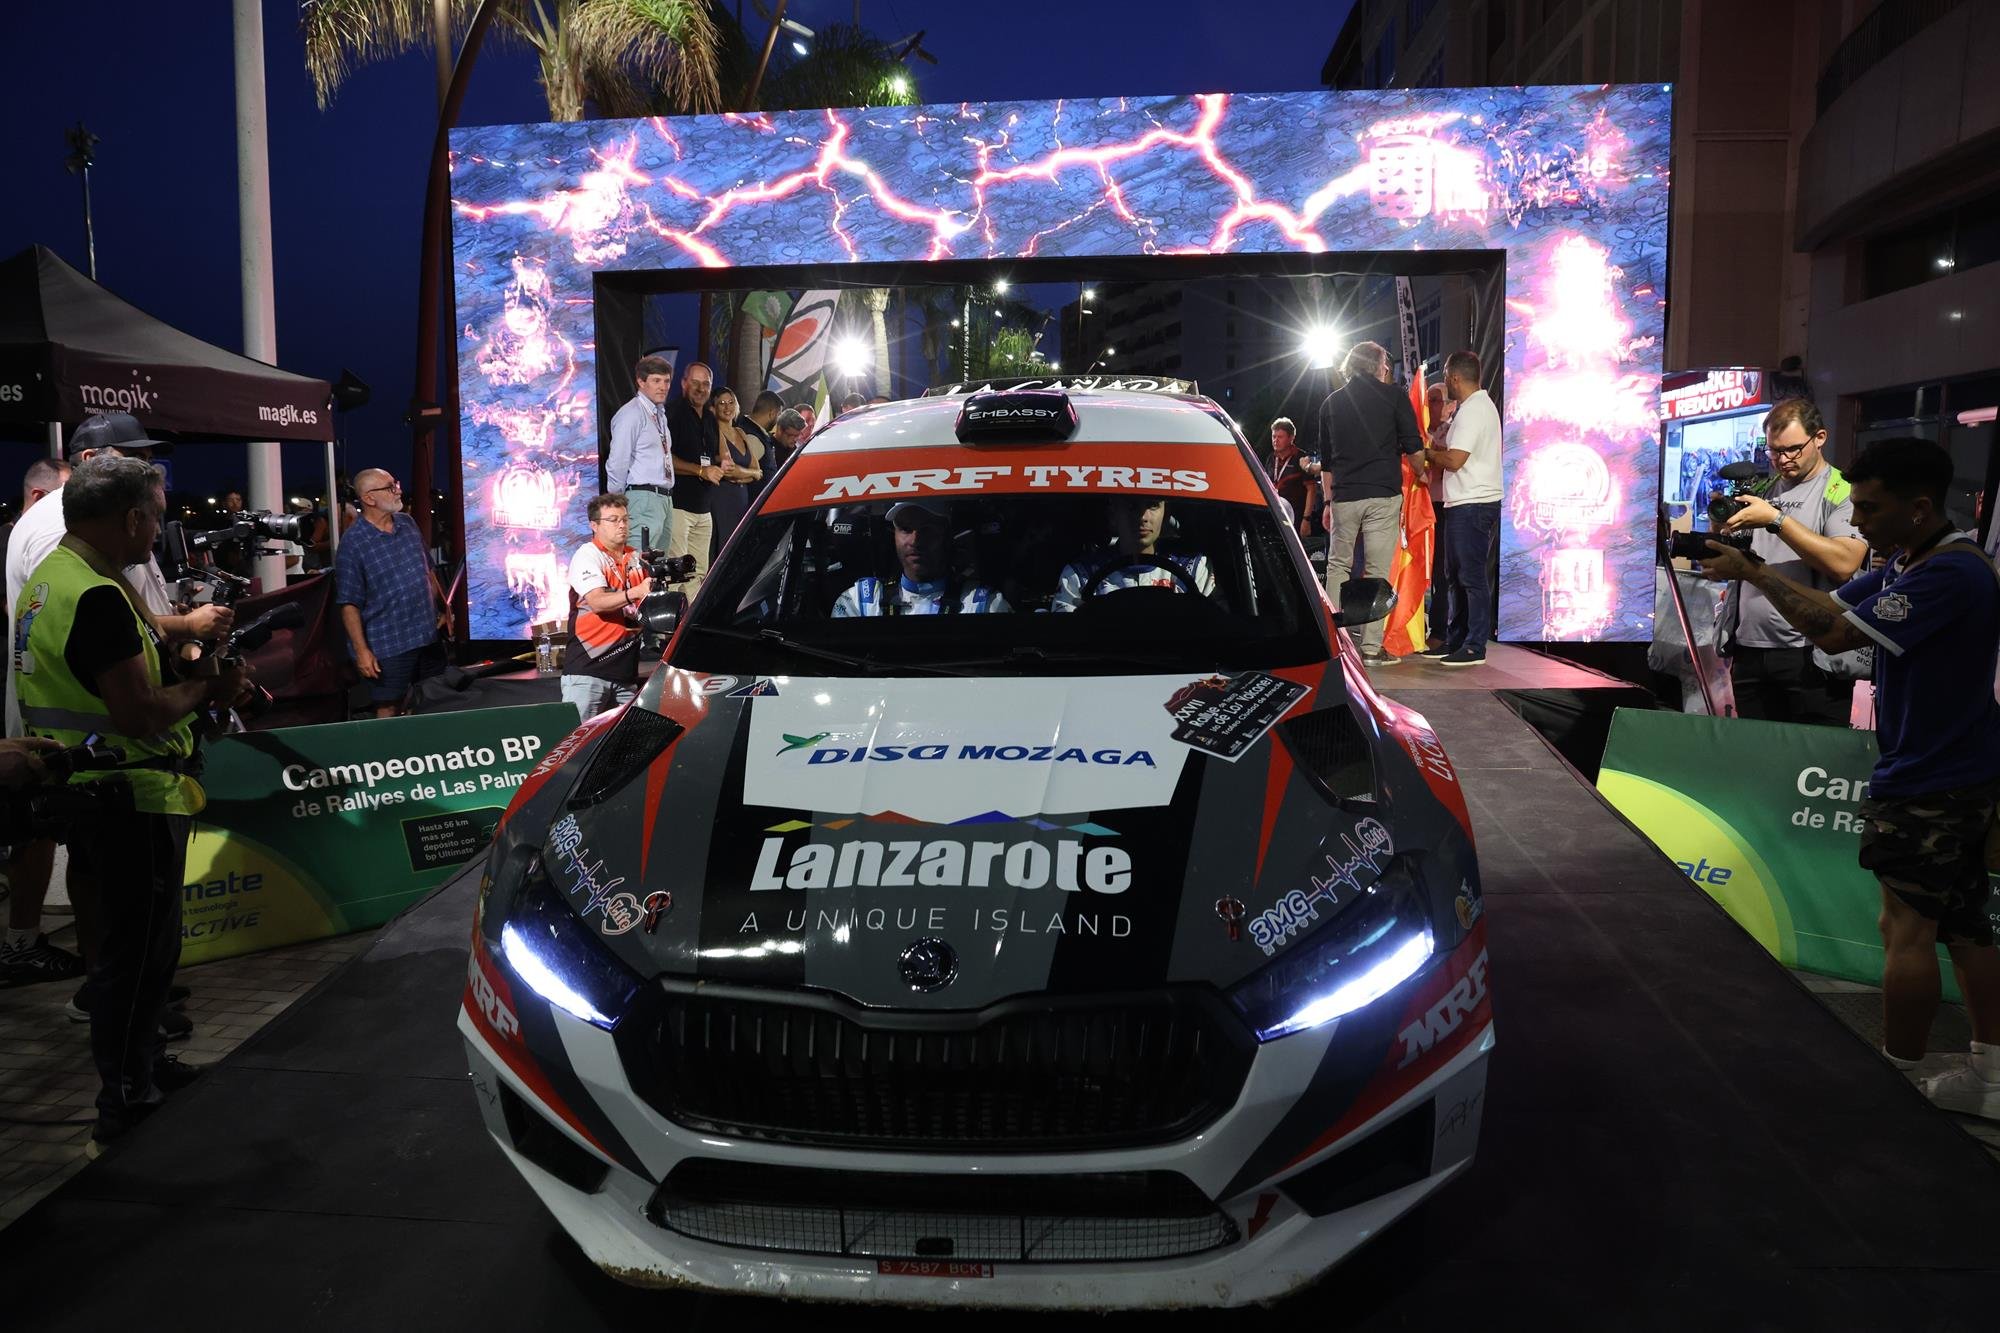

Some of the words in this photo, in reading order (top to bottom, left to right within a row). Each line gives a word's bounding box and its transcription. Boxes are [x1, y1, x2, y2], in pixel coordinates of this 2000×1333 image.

[79, 383, 152, 414] magik
[1676, 386, 1744, 417] REDUCTO
[258, 404, 318, 426] magik.es
[968, 408, 1060, 420] EMBASSY
[813, 466, 1013, 501] MRF
[1023, 465, 1211, 492] TYRES
[833, 524, 852, 535] OMP
[1188, 705, 1220, 728] Rallye
[1214, 713, 1231, 726] de
[1223, 701, 1244, 715] Los
[1238, 702, 1259, 721] Ciudad
[282, 744, 496, 792] Campeonato
[501, 735, 542, 763] BP
[958, 745, 1157, 767] MOZAGA
[292, 799, 321, 819] de
[325, 790, 406, 814] Rallyes
[410, 783, 437, 801] de
[443, 778, 477, 797] Las
[418, 823, 443, 833] Hasta
[443, 820, 455, 829] 56
[455, 819, 469, 827] km
[1791, 806, 1826, 829] de
[440, 831, 455, 841] por
[461, 837, 476, 846] con
[425, 853, 437, 862] bp
[438, 846, 474, 859] Ultimate
[749, 836, 1132, 895] Lanzarote
[739, 911, 759, 934] A
[786, 907, 948, 932] UNIQUE
[973, 908, 1132, 938] ISLAND
[1249, 890, 1311, 947] 3MG
[1397, 945, 1489, 1071] MRF
[882, 1260, 893, 1272] S
[900, 1260, 940, 1273] 7587
[949, 1263, 980, 1274] BCK
